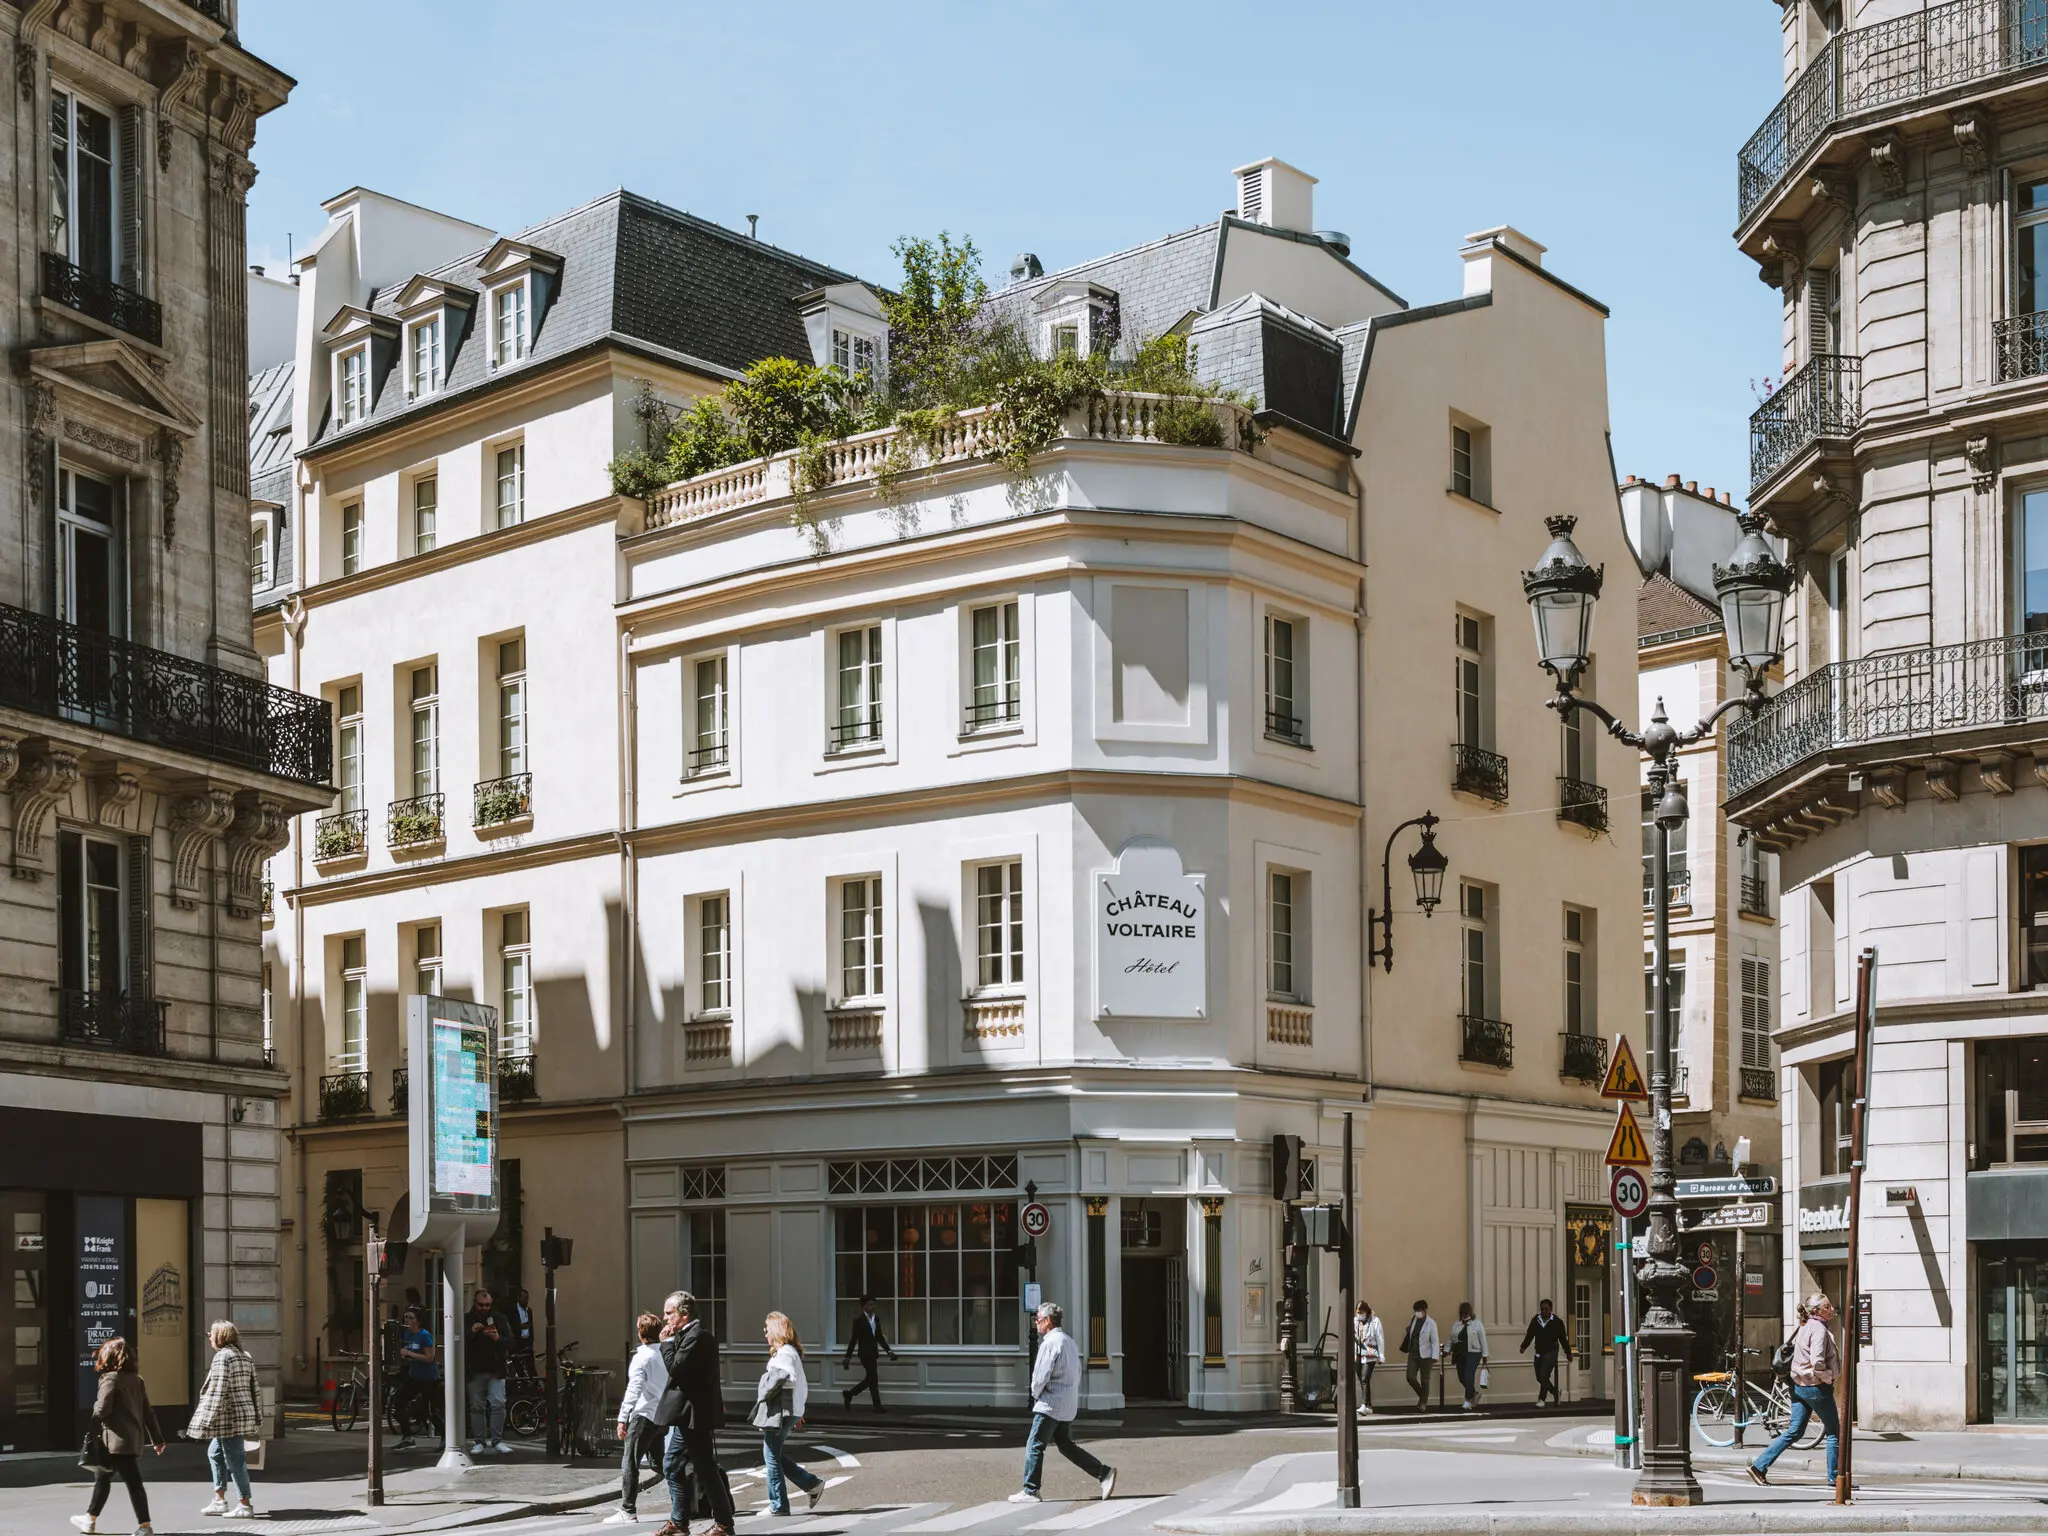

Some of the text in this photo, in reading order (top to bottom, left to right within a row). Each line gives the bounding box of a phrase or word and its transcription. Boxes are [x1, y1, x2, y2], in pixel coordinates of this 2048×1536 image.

[1106, 890, 1197, 919] CHÂTEAU
[1107, 923, 1196, 938] VOLTAIRE
[1124, 957, 1179, 974] Hôtel
[1618, 1182, 1640, 1203] 30
[1699, 1183, 1760, 1192] Bureau de Poste
[1028, 1212, 1045, 1227] 30
[1799, 1205, 1843, 1232] Reebok
[96, 1237, 114, 1246] Knight
[1701, 1249, 1710, 1259] 30
[98, 1284, 114, 1295] JLL
